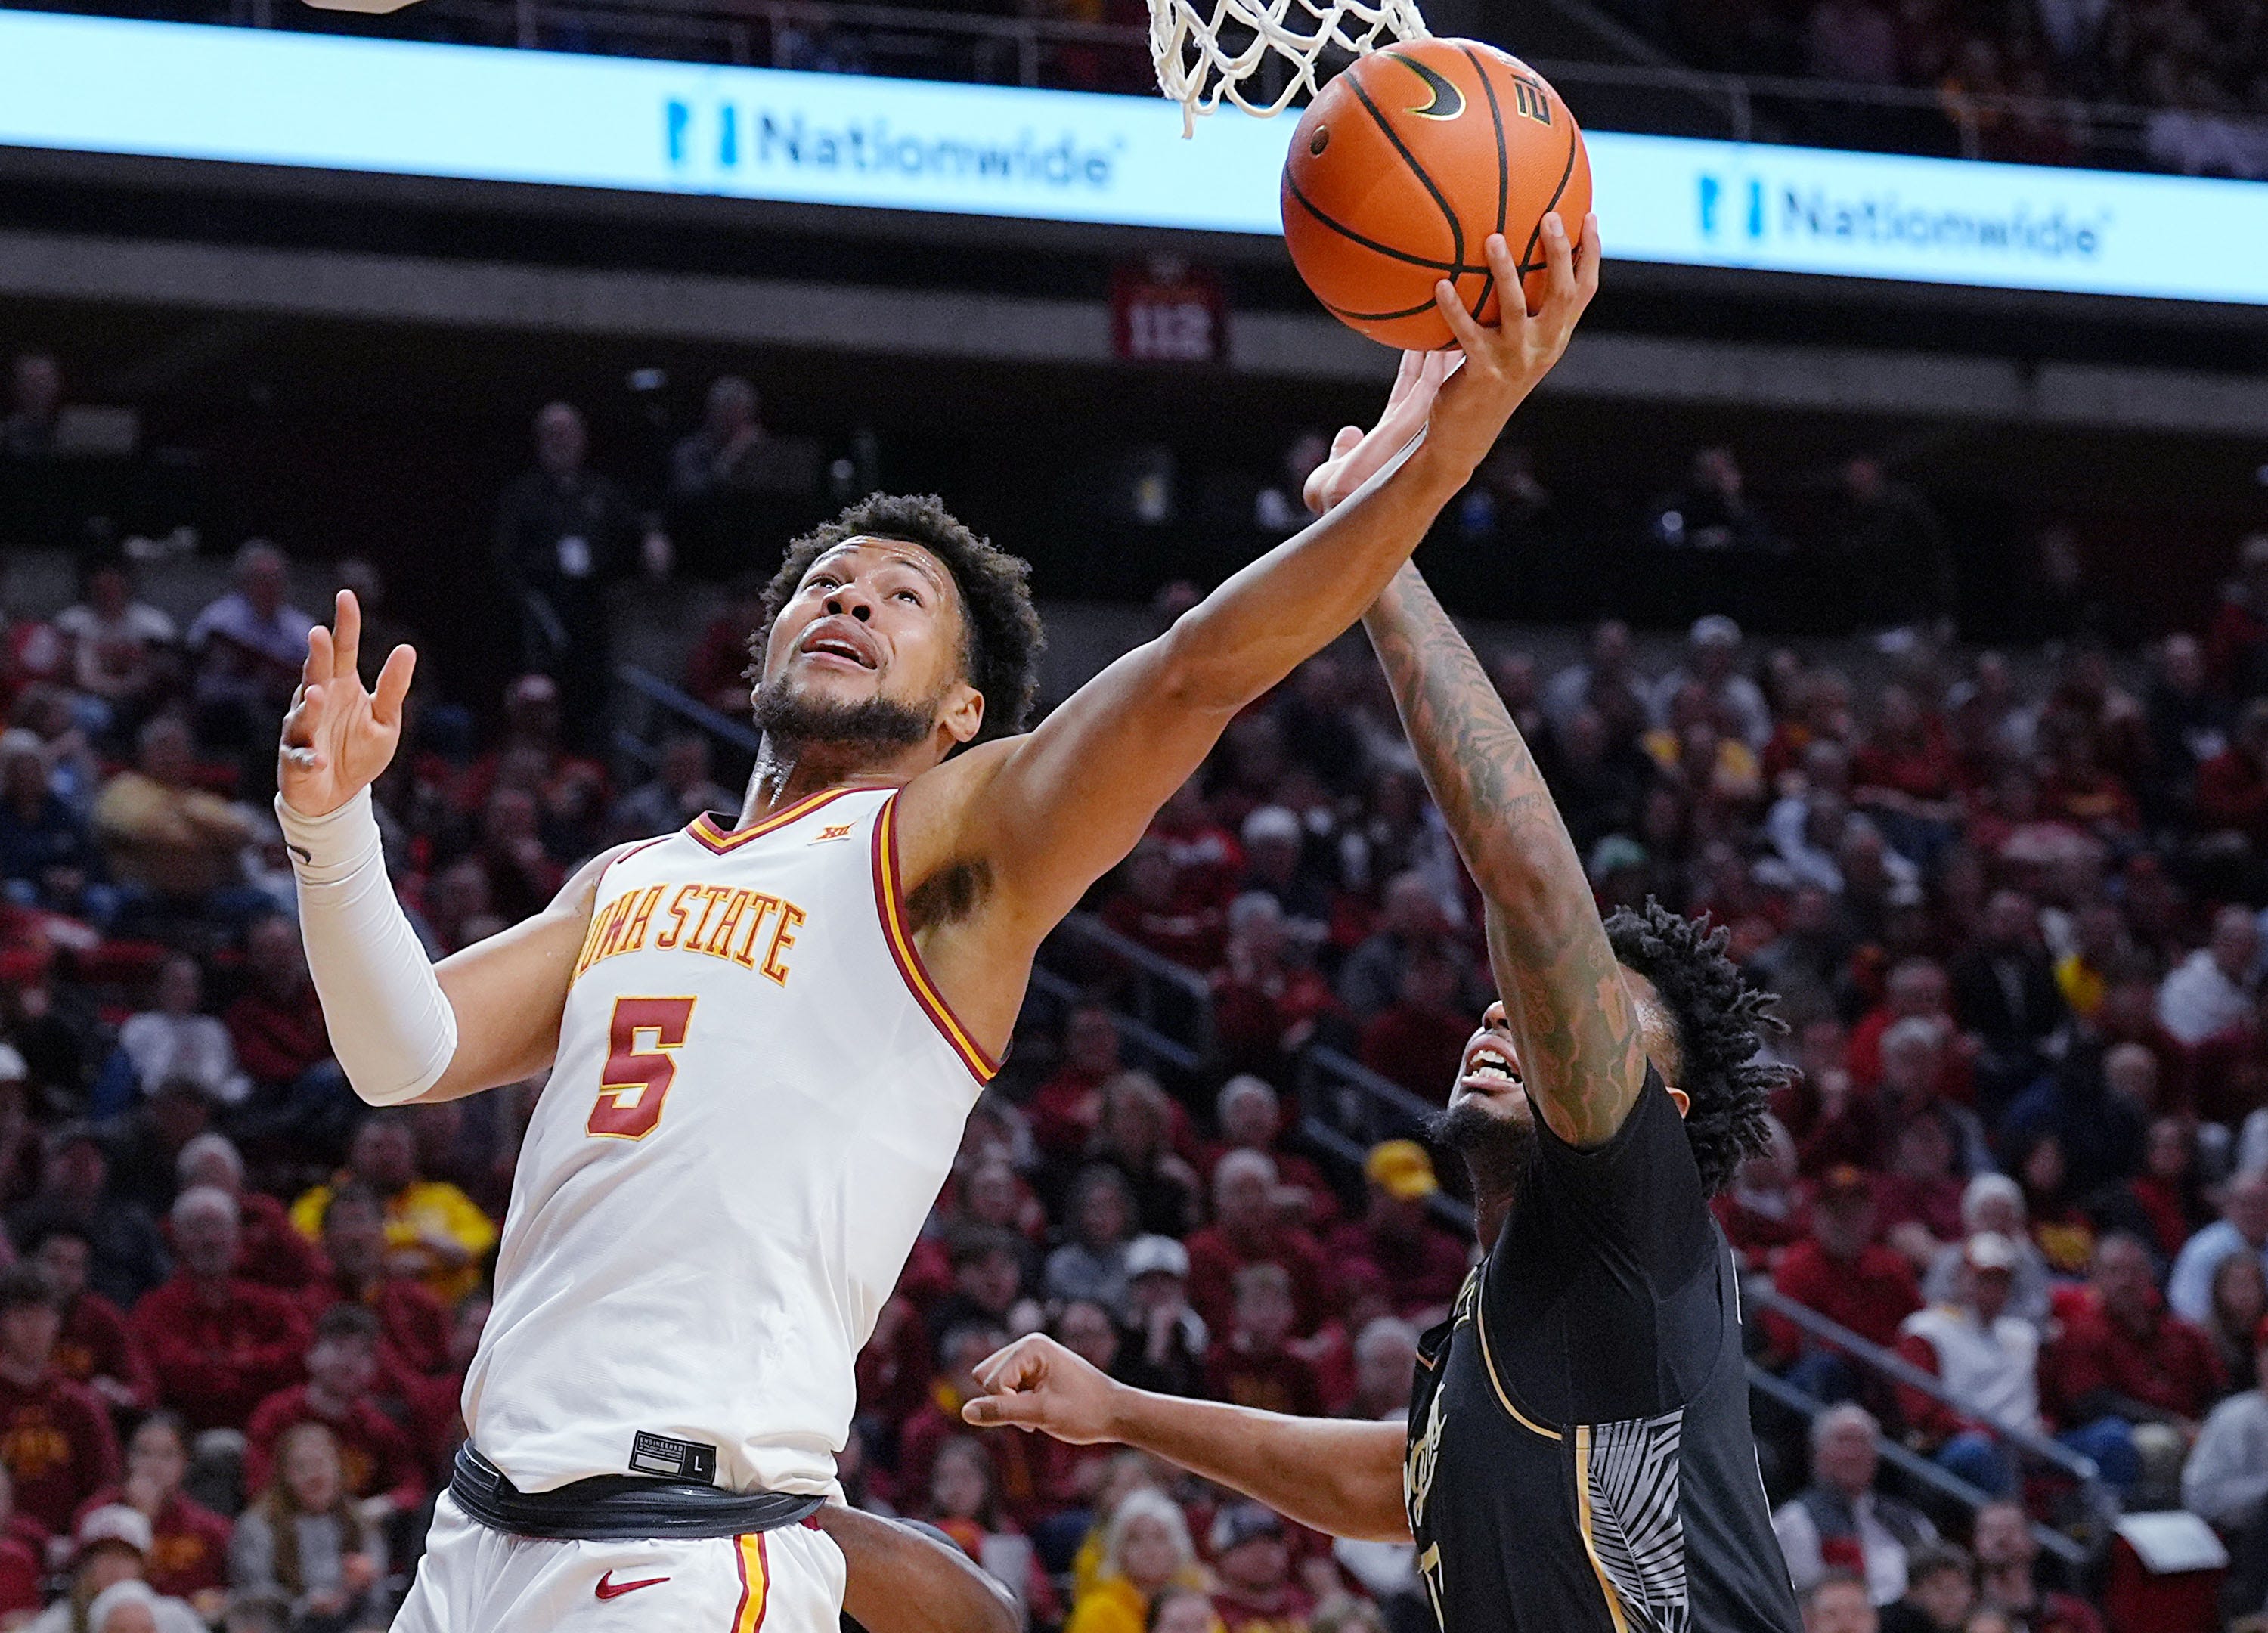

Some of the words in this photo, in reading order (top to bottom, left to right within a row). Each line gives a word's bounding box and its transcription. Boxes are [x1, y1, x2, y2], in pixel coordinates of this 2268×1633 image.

[758, 111, 1114, 189] Nationwide
[1783, 187, 2097, 260] Nationwide
[571, 883, 669, 987] OWA
[655, 883, 807, 987] STATE
[587, 994, 697, 1141] 5
[694, 1455, 702, 1471] L
